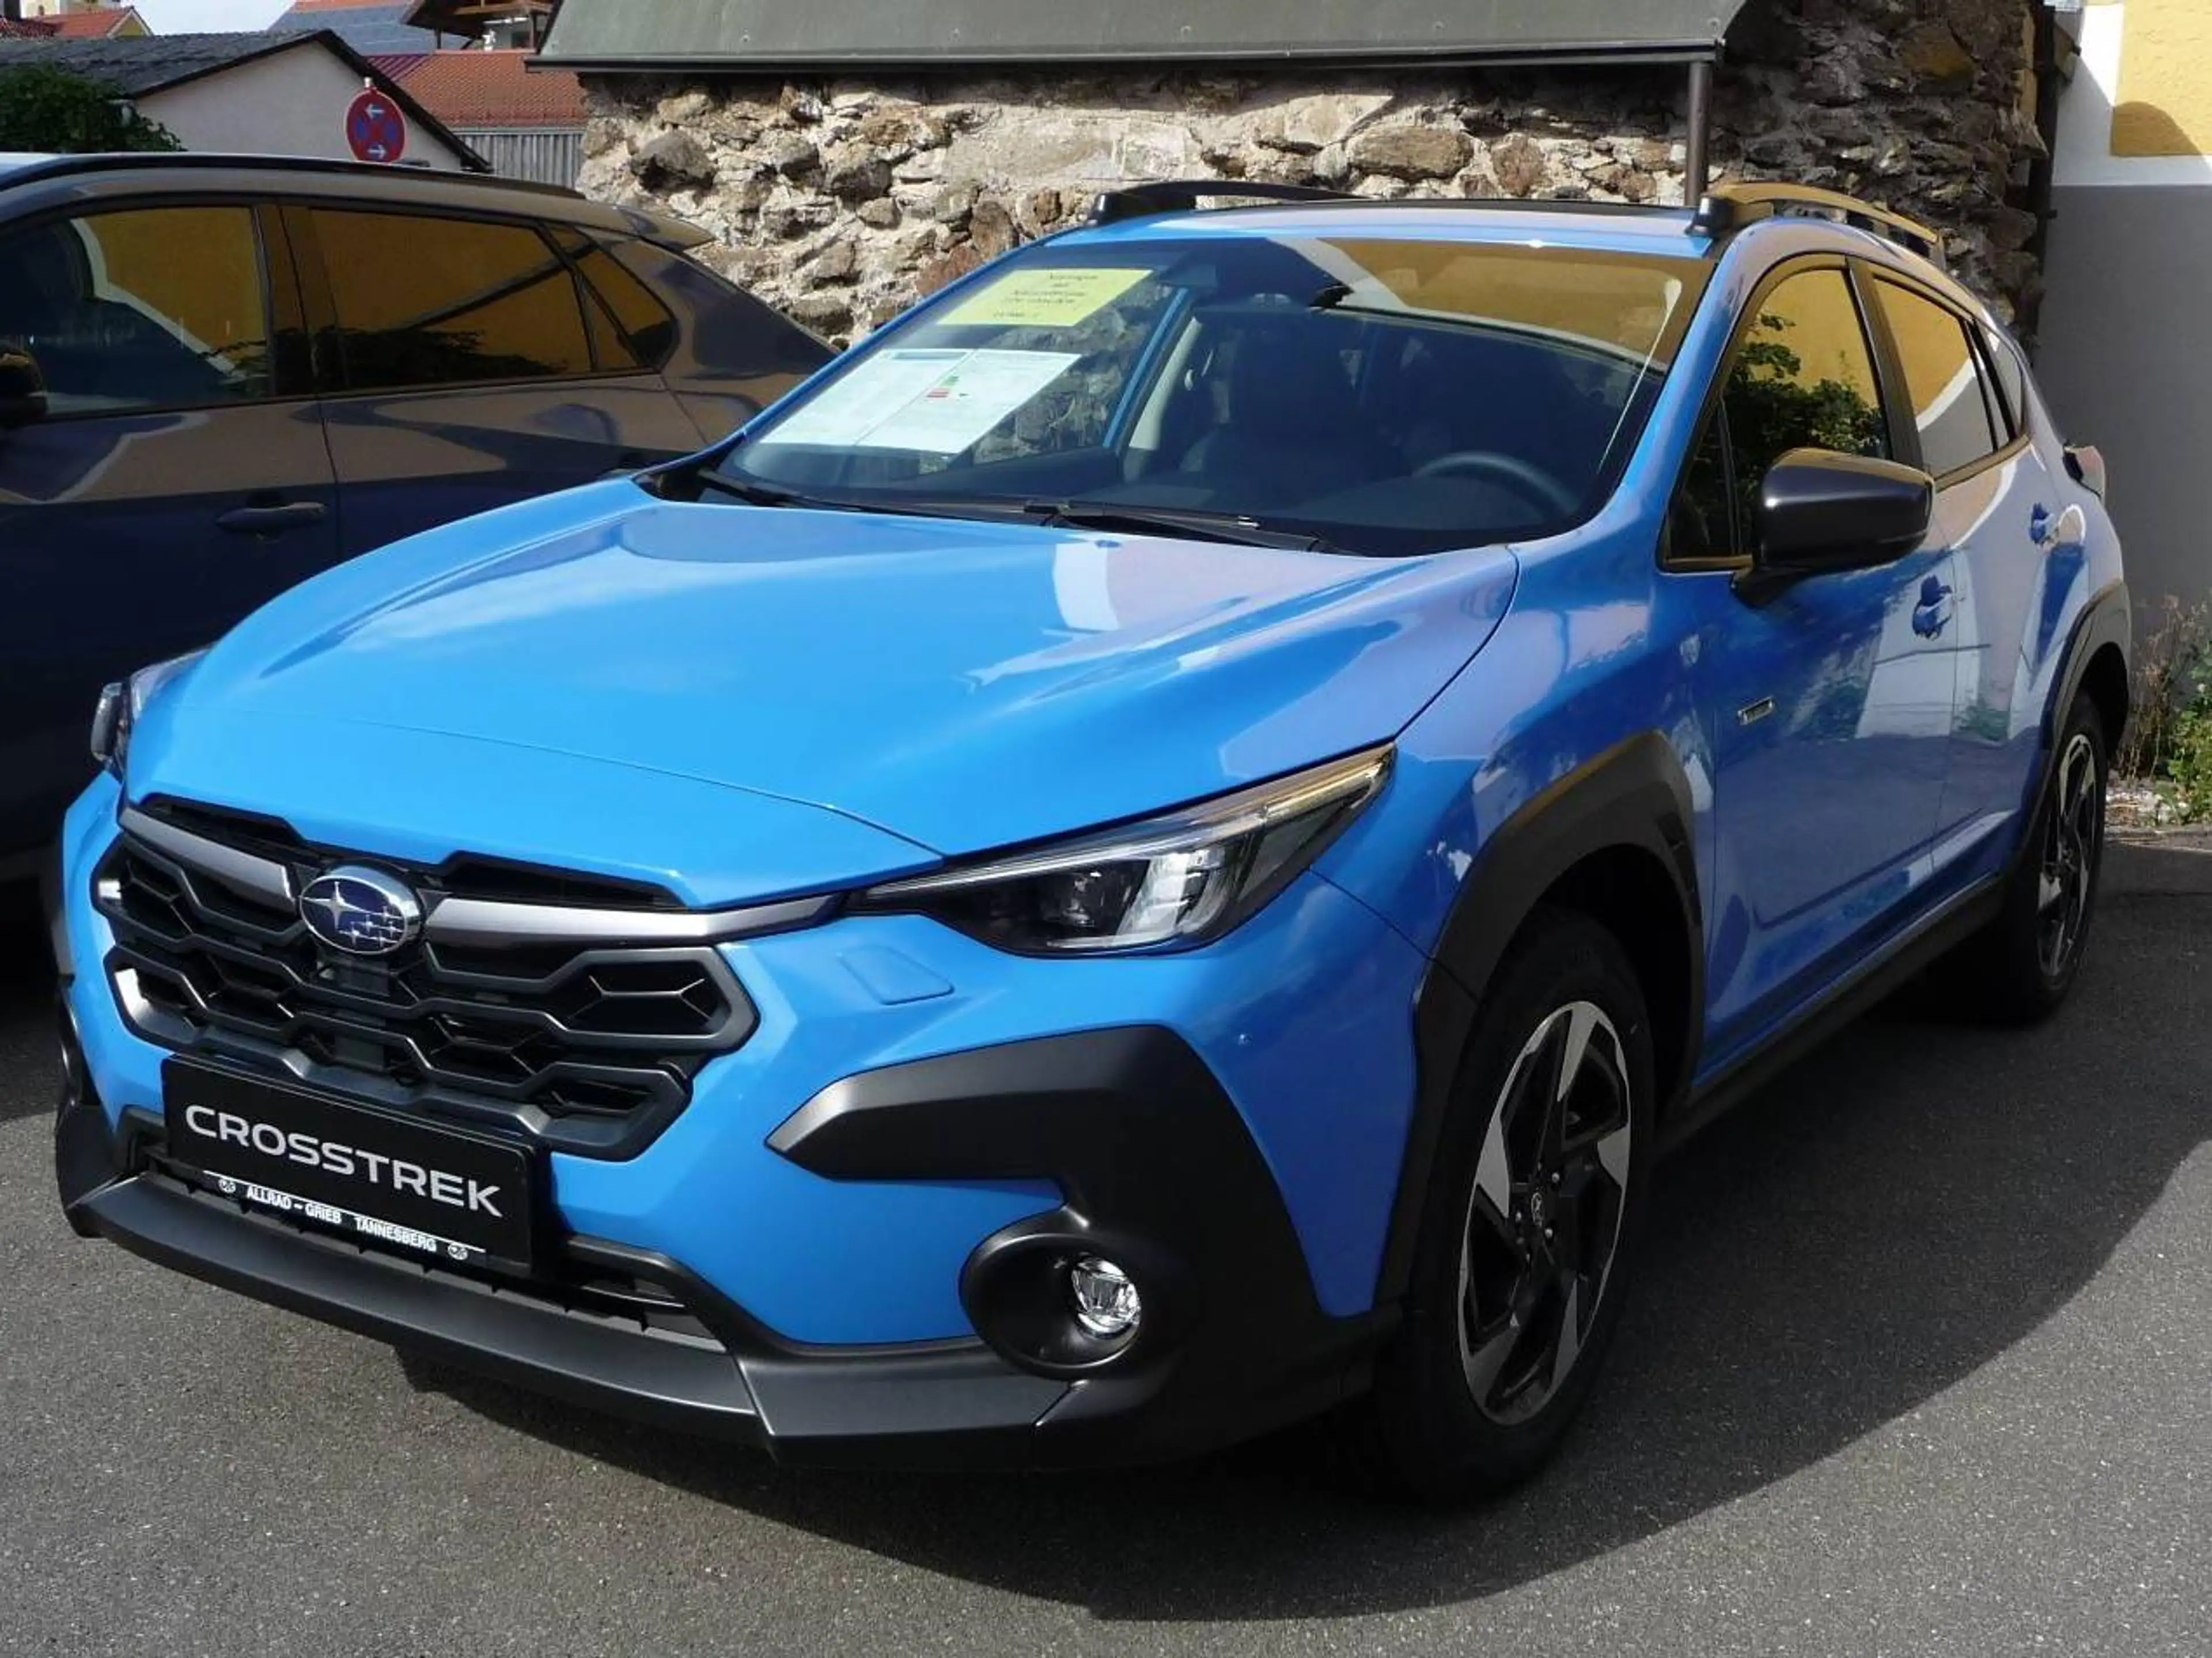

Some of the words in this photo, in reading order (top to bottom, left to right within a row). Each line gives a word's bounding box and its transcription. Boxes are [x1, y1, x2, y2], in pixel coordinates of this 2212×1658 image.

[186, 1105, 502, 1216] CROSSTREK
[247, 1185, 291, 1210] ALLRAD
[305, 1202, 342, 1224] GRIEB
[355, 1216, 436, 1251] TANNESBERG
